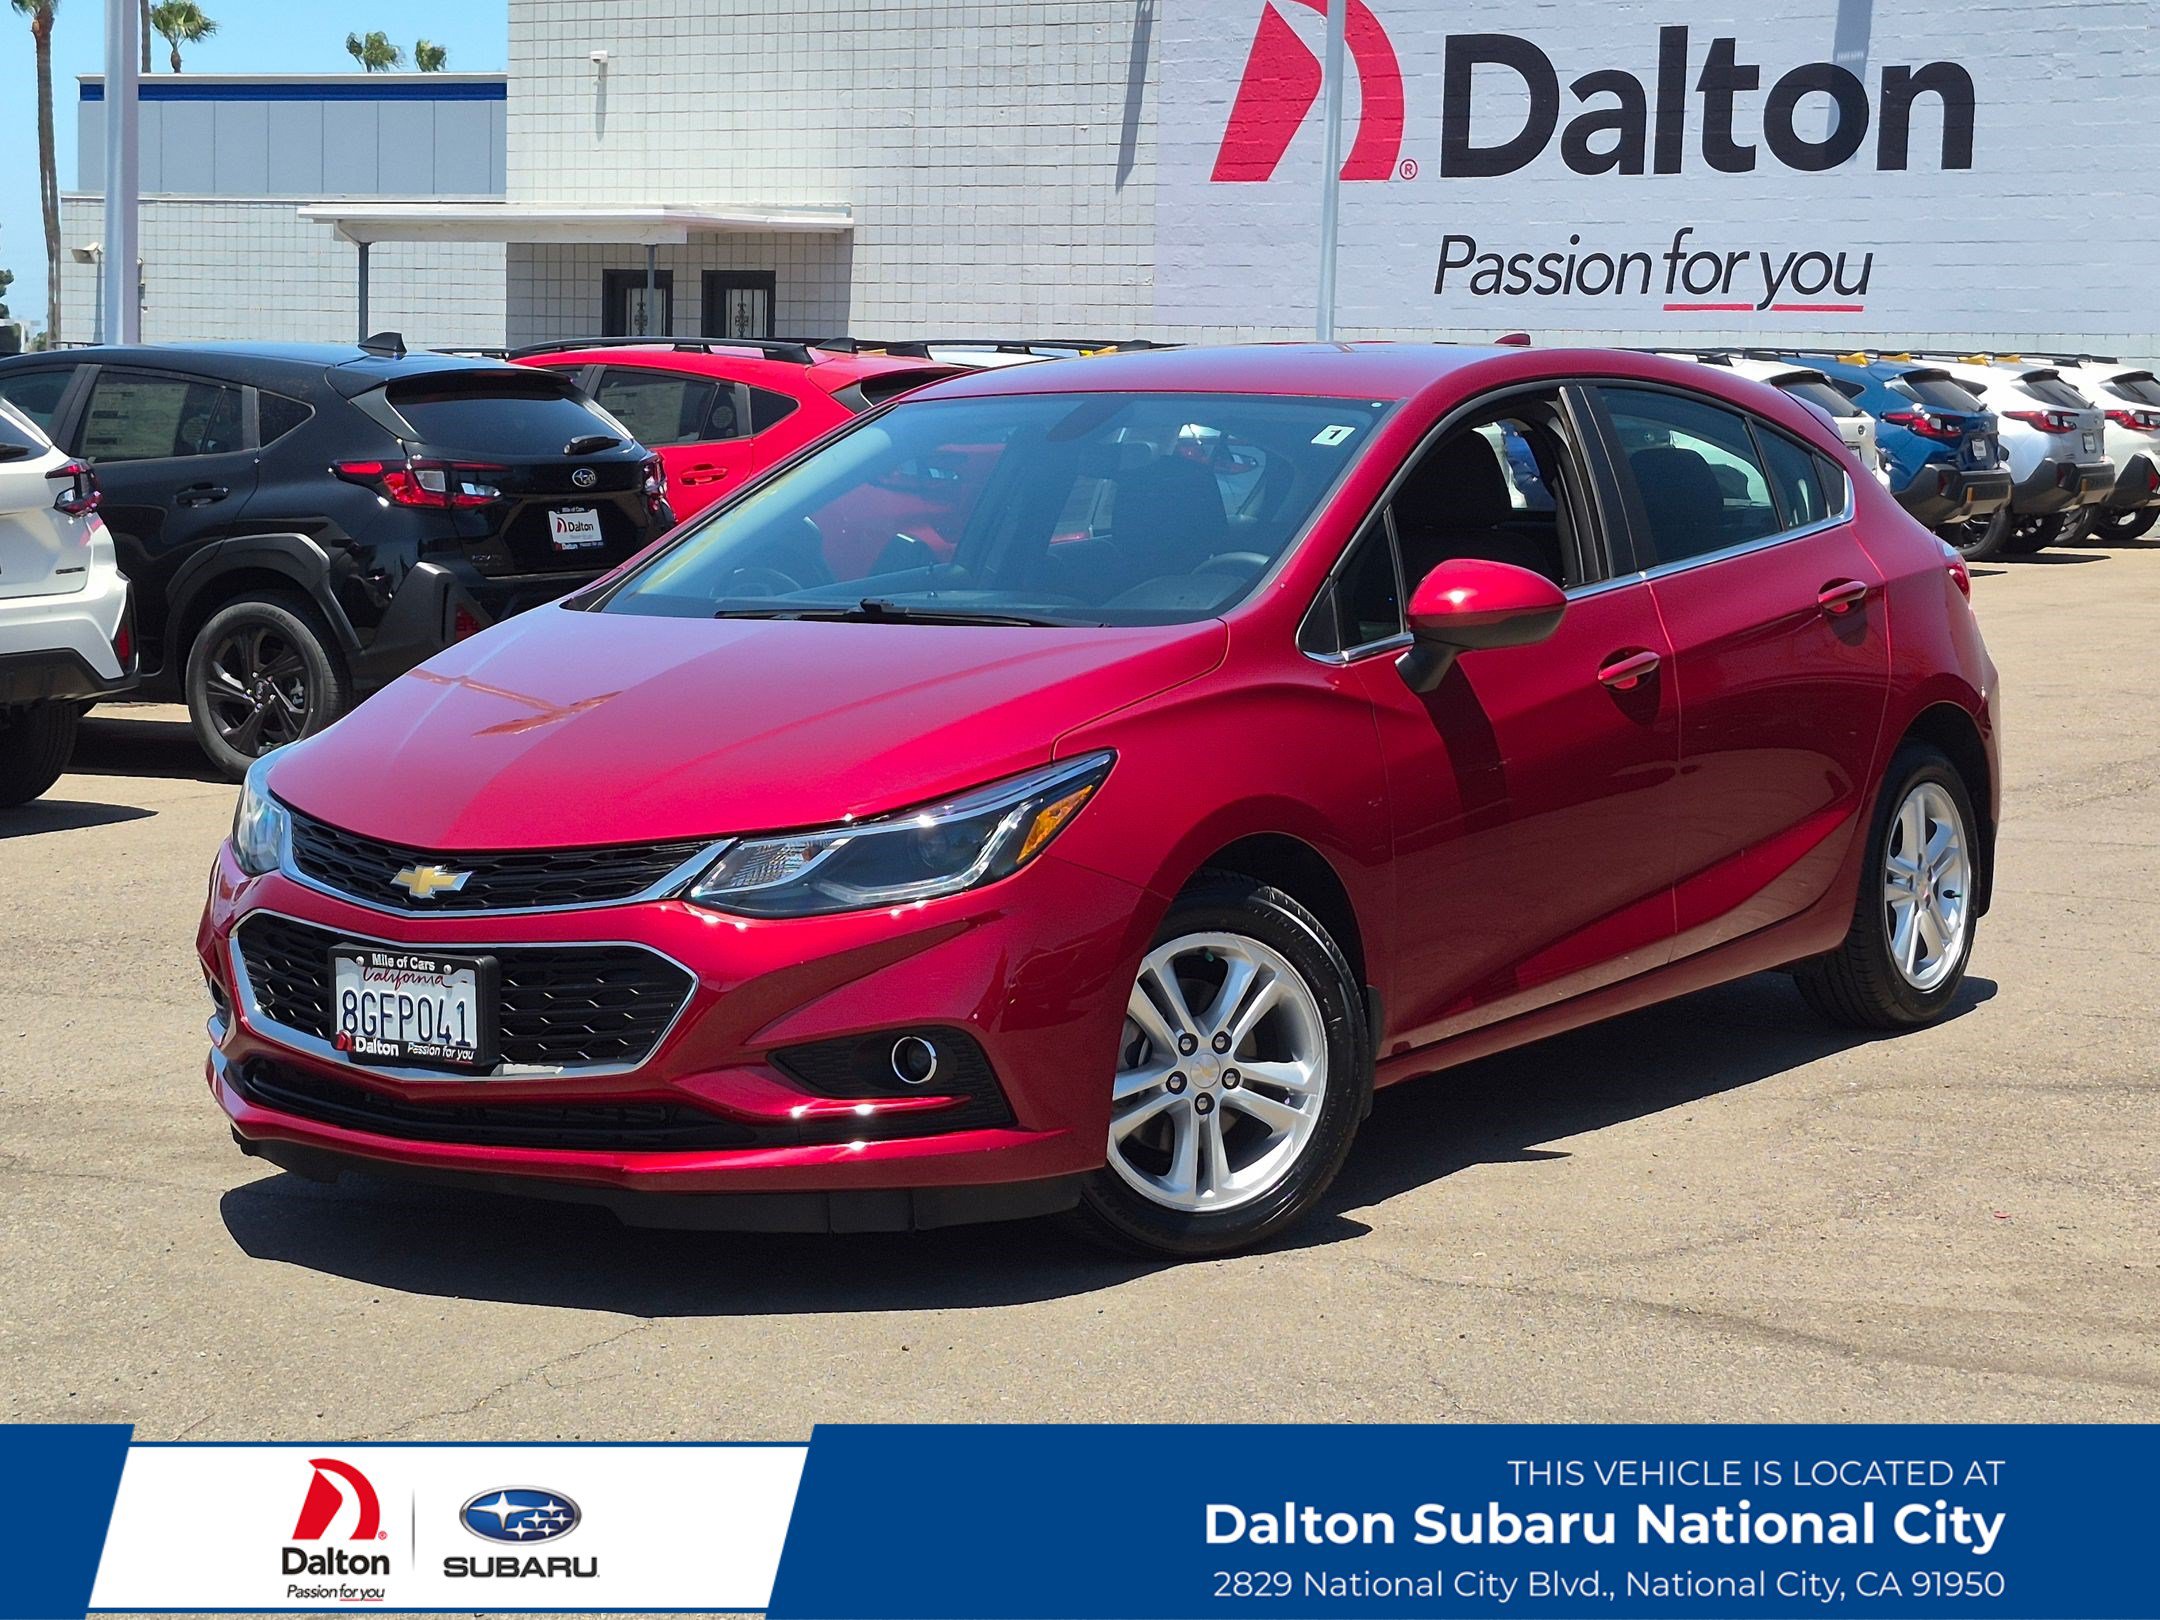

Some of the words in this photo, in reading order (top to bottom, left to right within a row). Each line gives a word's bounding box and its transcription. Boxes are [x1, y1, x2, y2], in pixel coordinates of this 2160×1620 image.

[1441, 26, 1975, 178] Dalton
[1434, 233, 1650, 296] Passion
[1663, 227, 1751, 296] for
[1757, 251, 1873, 311] you
[568, 520, 594, 532] Dalton
[372, 953, 394, 967] Mile
[397, 955, 408, 968] of
[410, 957, 436, 971] Cars
[363, 966, 453, 990] California
[342, 989, 471, 1047] 8GFP041
[355, 1037, 399, 1056] Dalton
[407, 1041, 441, 1057] Passion
[442, 1045, 455, 1058] for
[456, 1048, 475, 1061] you
